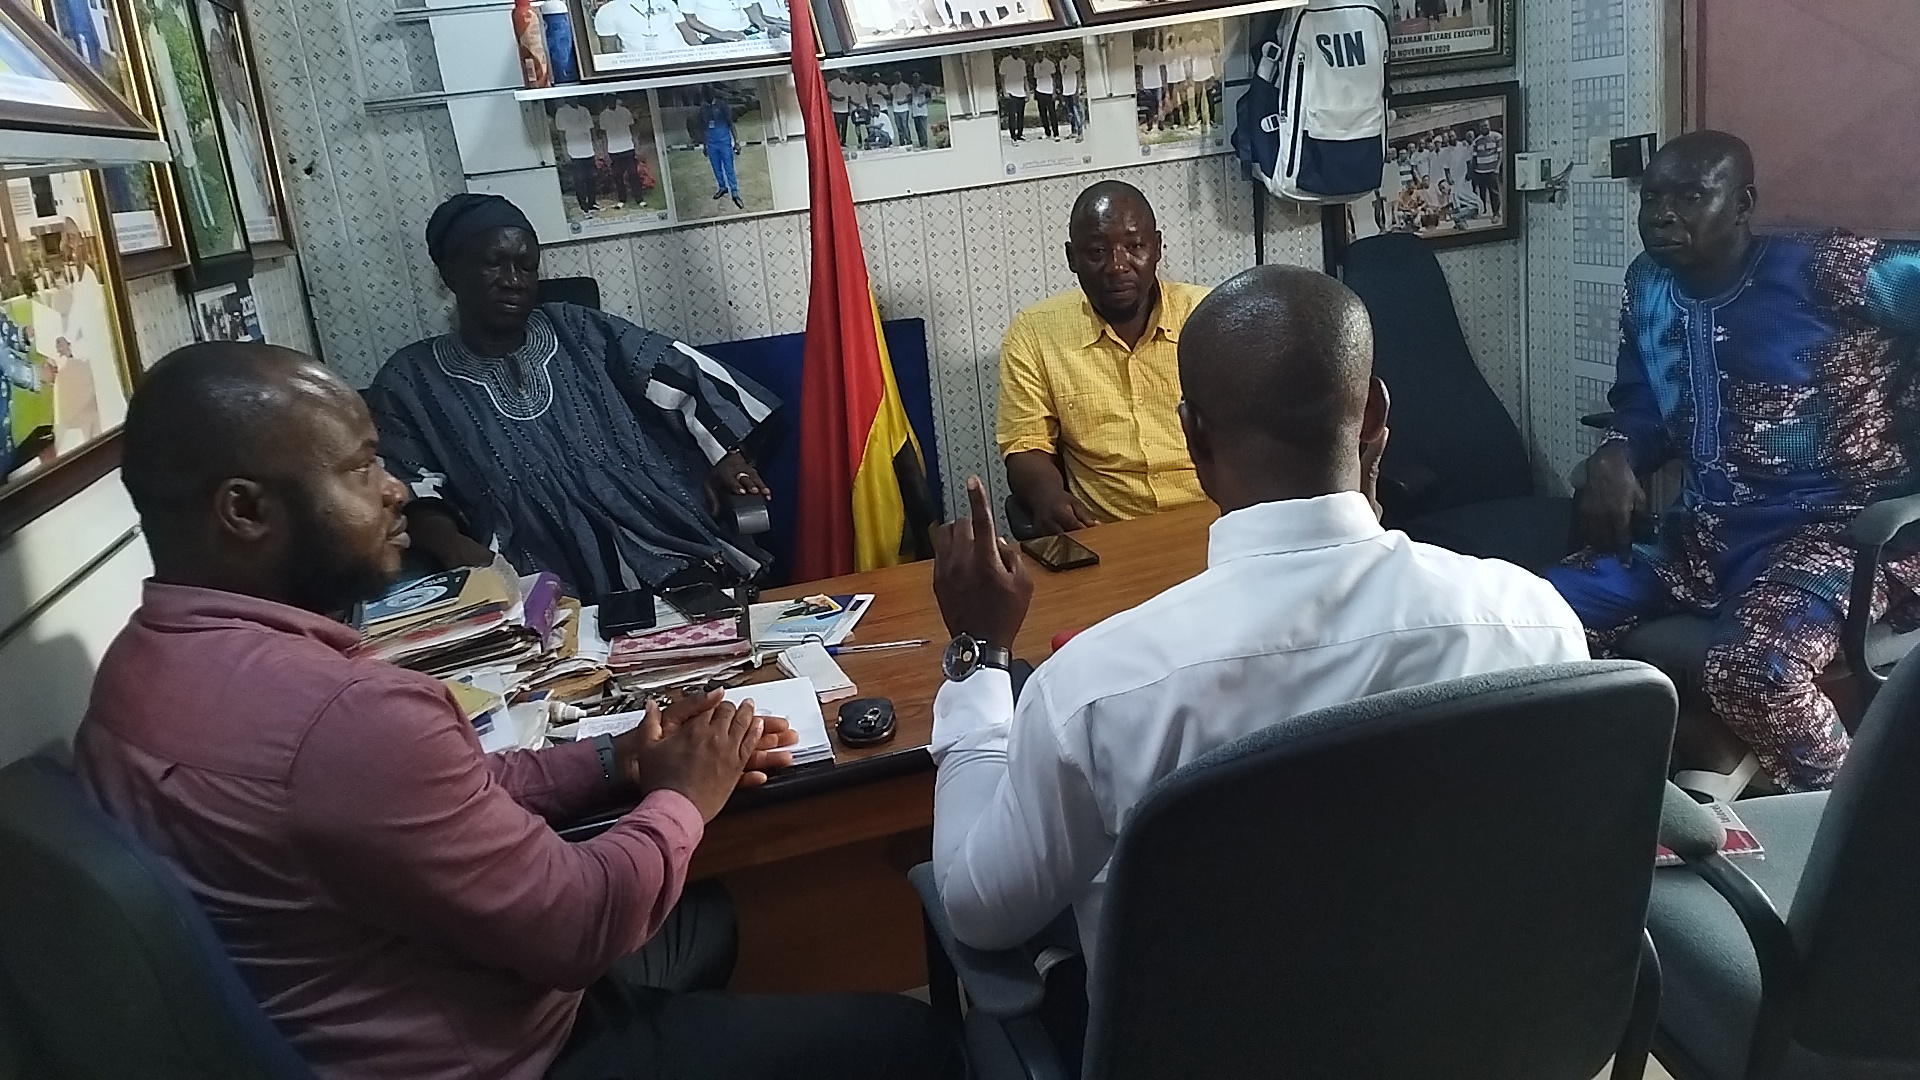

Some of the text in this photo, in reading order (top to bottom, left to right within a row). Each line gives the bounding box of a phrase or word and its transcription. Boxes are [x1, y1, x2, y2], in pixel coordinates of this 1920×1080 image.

[1424, 31, 1452, 42] WELFARE
[1453, 28, 1491, 39] EXECUTIVES
[1315, 31, 1367, 68] SIN
[1397, 46, 1433, 57] NOVEMBER
